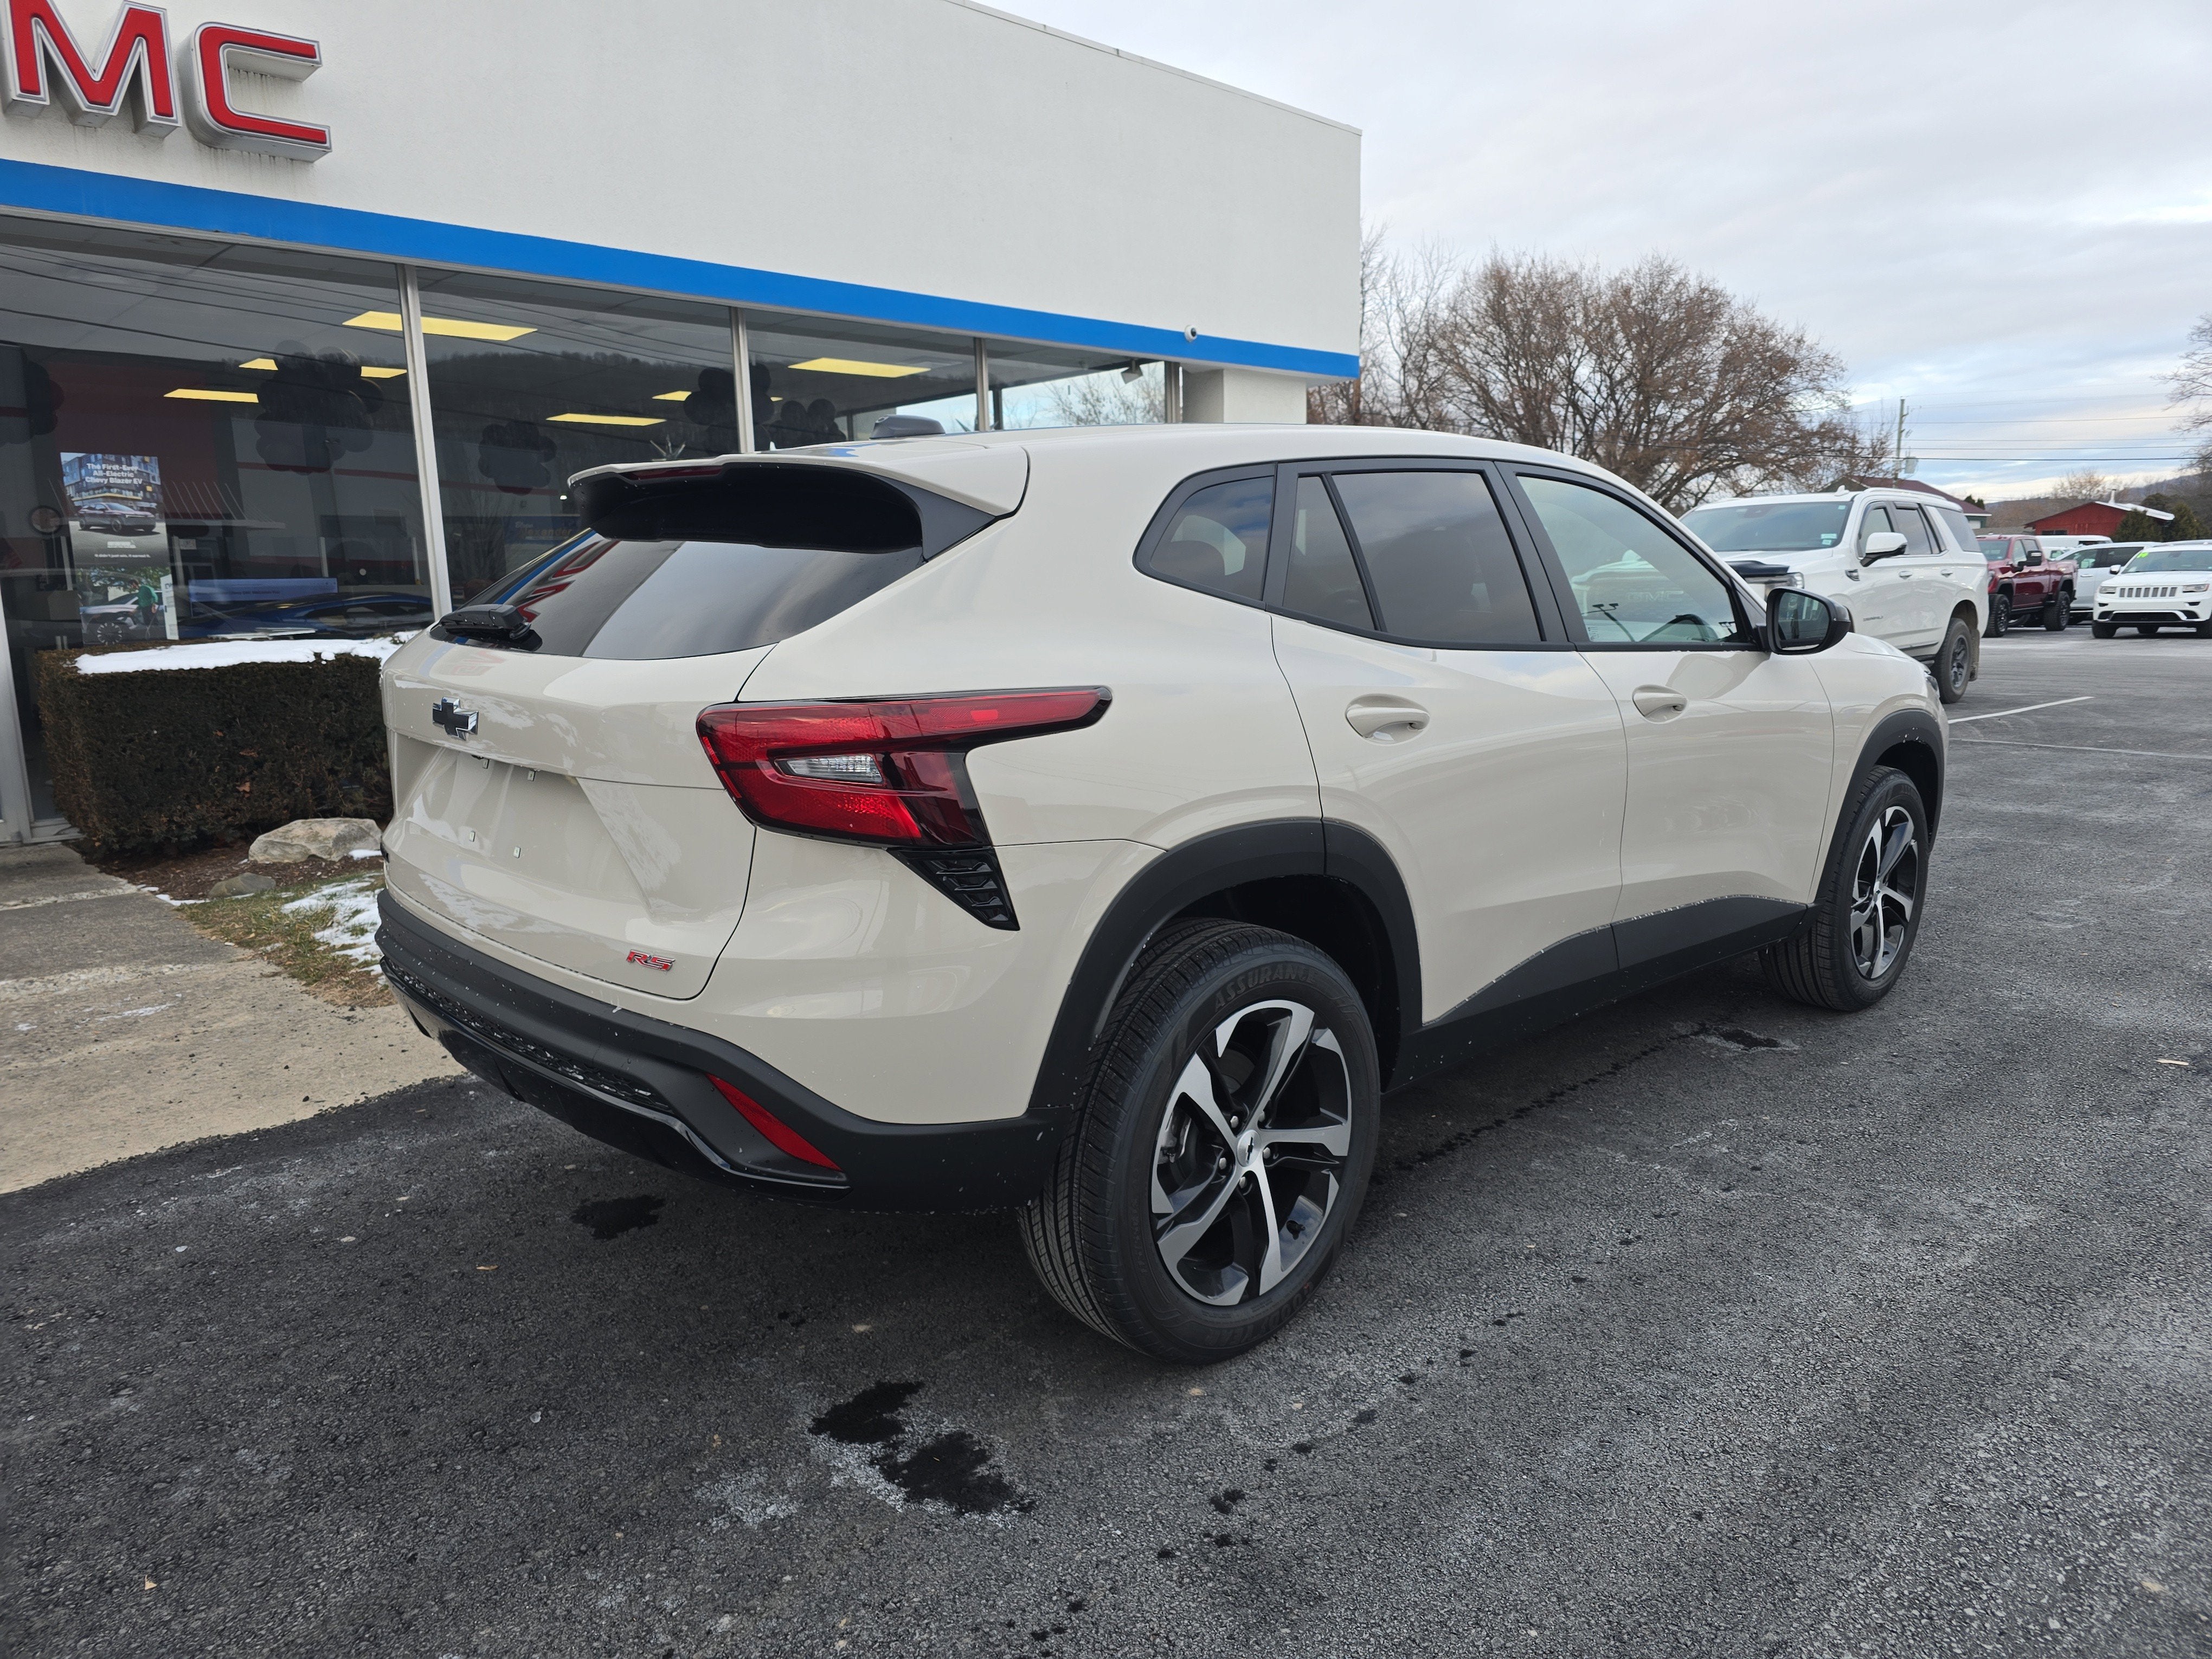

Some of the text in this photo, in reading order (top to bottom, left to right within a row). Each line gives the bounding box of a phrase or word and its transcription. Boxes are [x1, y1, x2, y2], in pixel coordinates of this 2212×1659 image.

[4, 0, 333, 158] MC
[626, 949, 676, 971] RS
[1215, 962, 1318, 1012] ASSURANCE
